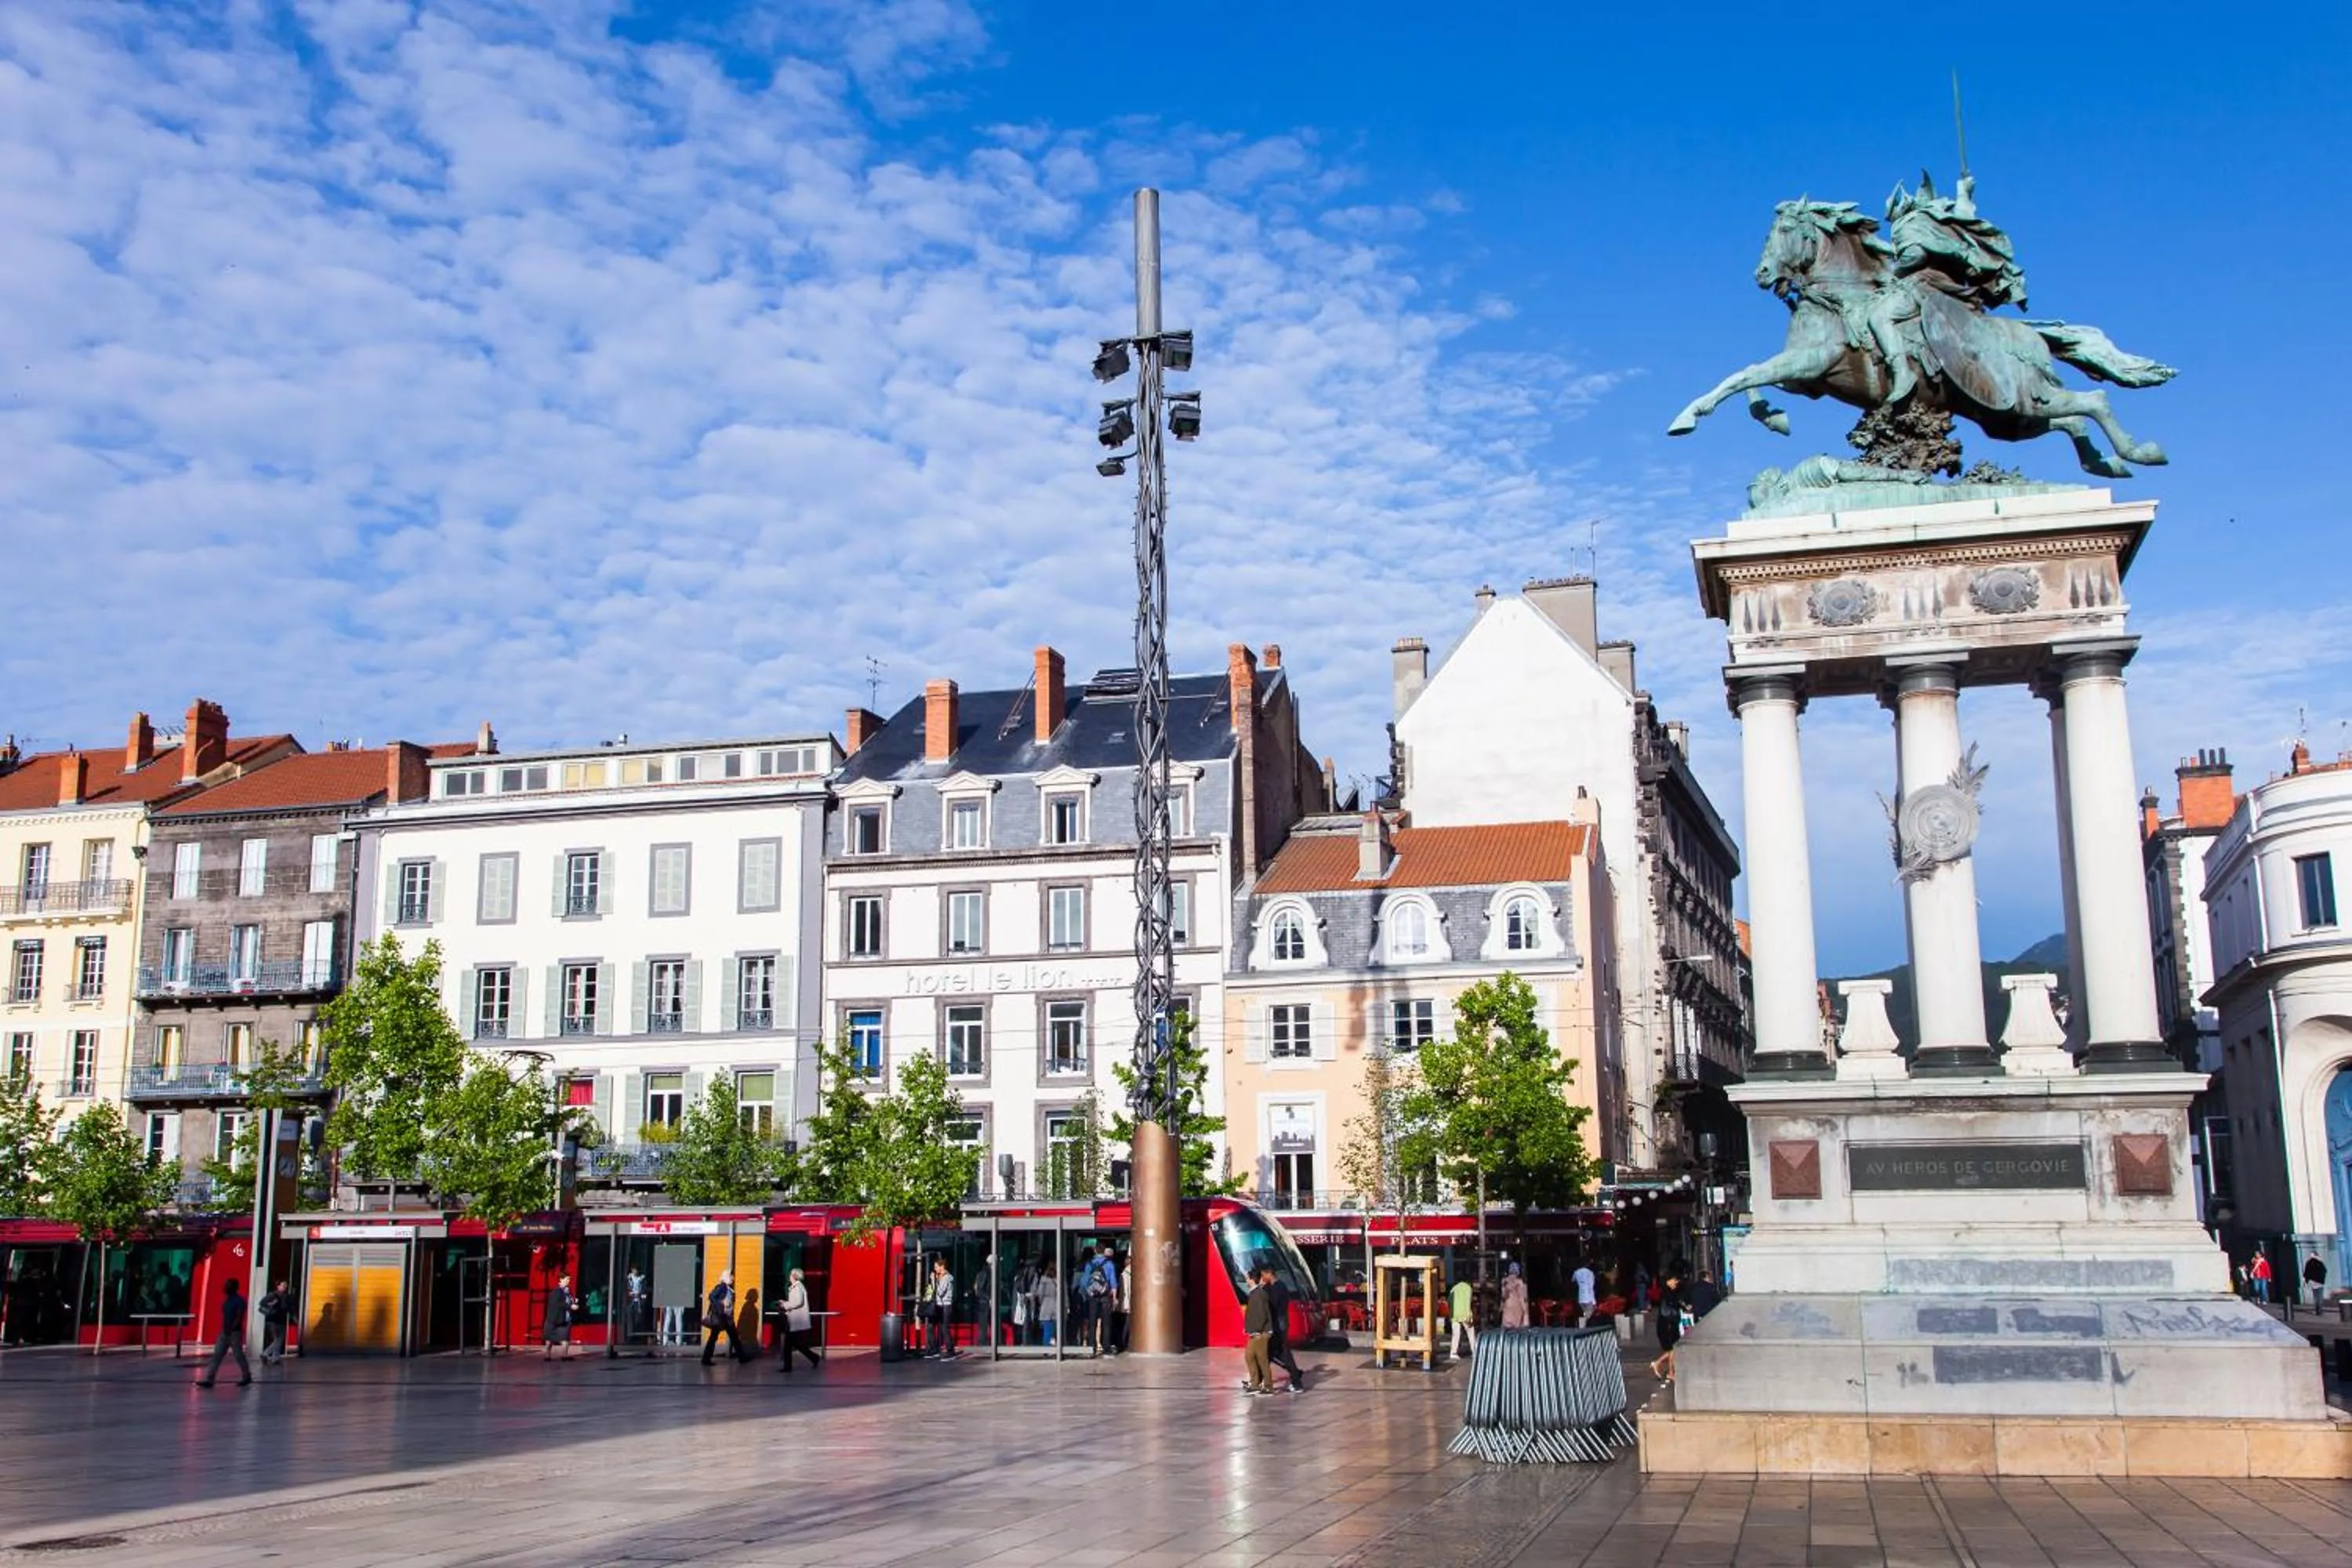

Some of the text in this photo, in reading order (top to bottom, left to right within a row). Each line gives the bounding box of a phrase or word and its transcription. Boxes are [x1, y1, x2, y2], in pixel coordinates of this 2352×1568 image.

[906, 964, 1072, 993] hotel le lion
[1893, 1160, 1947, 1174] HEROS
[1954, 1160, 1975, 1174] DE
[1983, 1159, 2071, 1174] GERGOVIE
